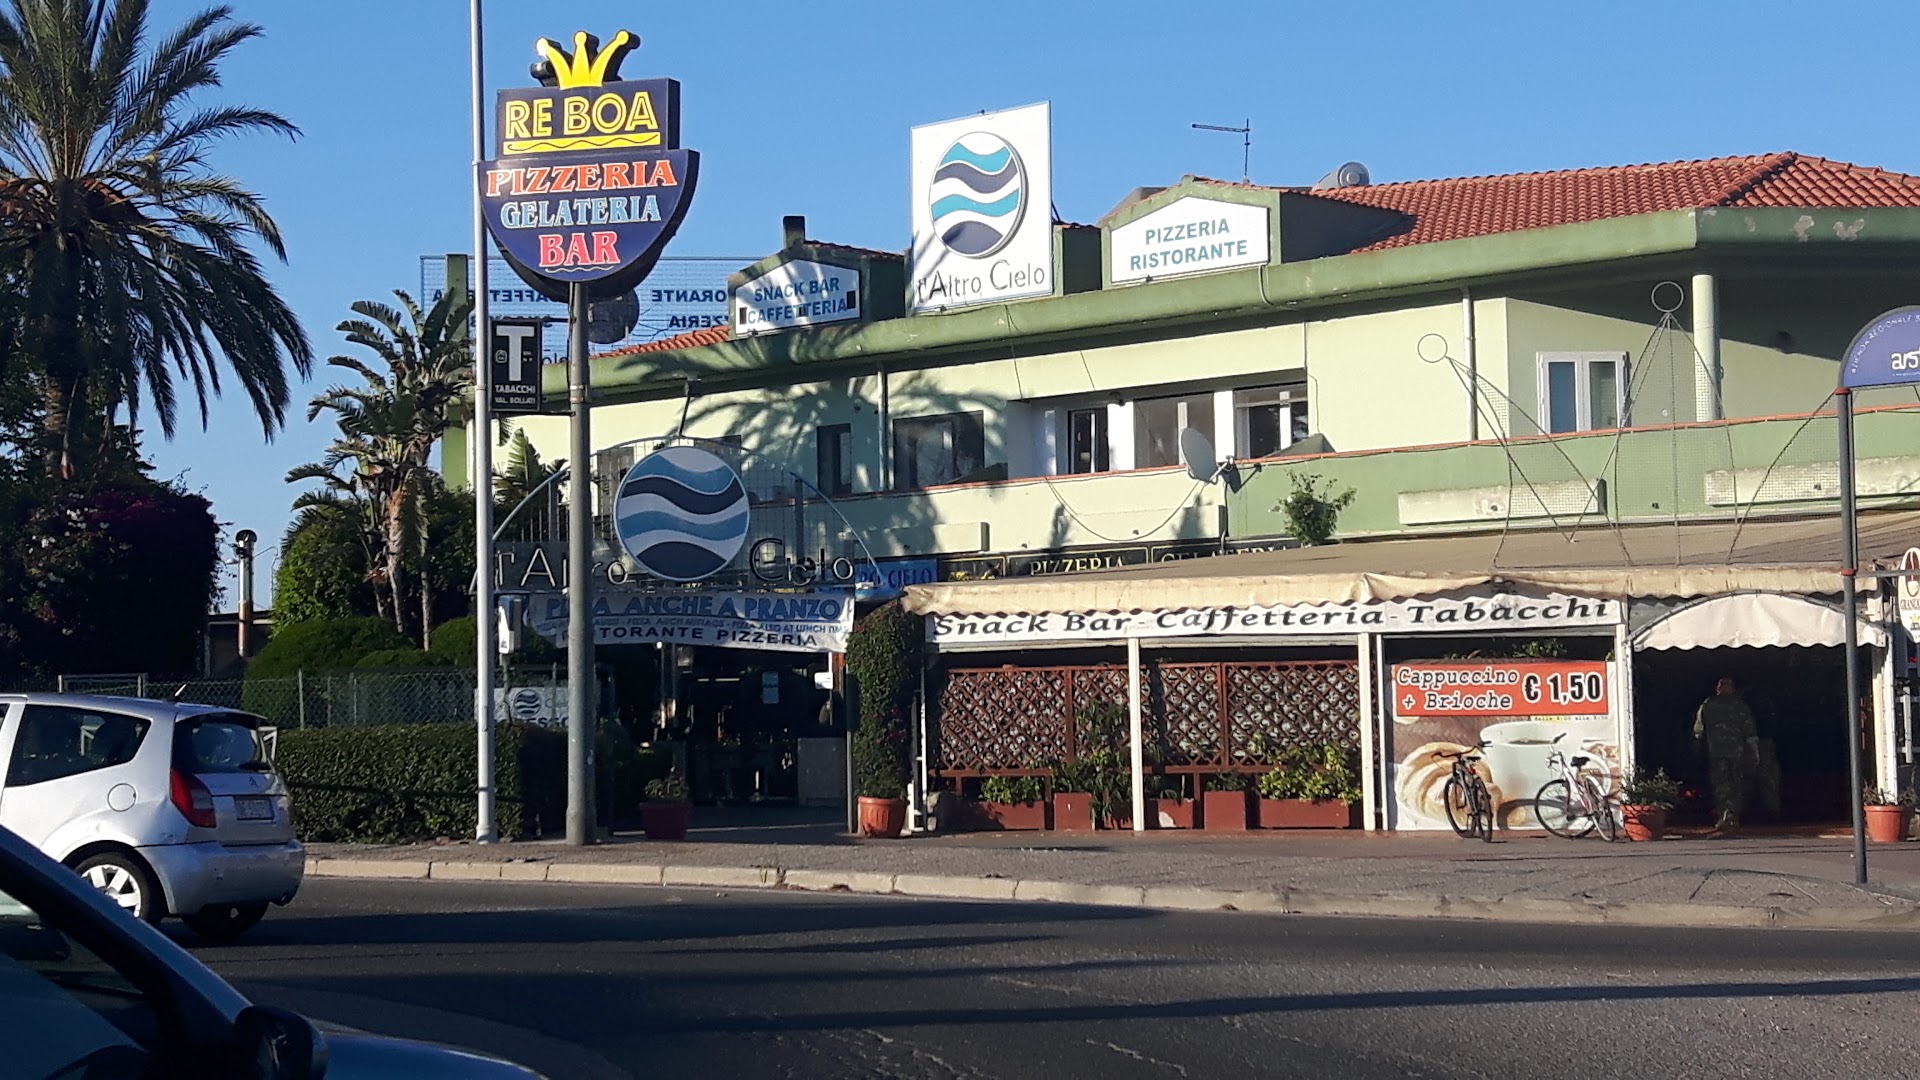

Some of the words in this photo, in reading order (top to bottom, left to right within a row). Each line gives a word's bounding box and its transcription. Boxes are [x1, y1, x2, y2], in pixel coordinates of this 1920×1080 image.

[505, 98, 552, 139] RE
[564, 92, 659, 135] BOA
[486, 160, 678, 197] PIZZERIA
[500, 195, 661, 229] GELATERIA
[1145, 218, 1230, 245] PIZZERIA
[538, 231, 621, 267] BAR
[1130, 240, 1248, 271] RISTORANTE
[755, 281, 804, 302] SNACK
[810, 277, 839, 294] BAR
[990, 259, 1045, 291] Cielo
[748, 298, 848, 324] CAFFETTERIA
[496, 325, 535, 382] T
[495, 384, 536, 394] TABACCHI
[624, 596, 713, 616] ANCHE
[717, 597, 738, 617] A
[745, 597, 841, 620] PRANZO
[934, 614, 1049, 636] Snack
[1063, 614, 1132, 632] Bar
[1156, 606, 1384, 632] Caffetteria
[1407, 597, 1608, 625] Tabacchi
[717, 629, 817, 646] PIZZERIA
[1397, 666, 1519, 689] Cappuccino
[1523, 673, 1540, 702] €
[1547, 672, 1602, 704] 1,50
[1402, 697, 1415, 710] +
[1425, 689, 1512, 710] Brioche
